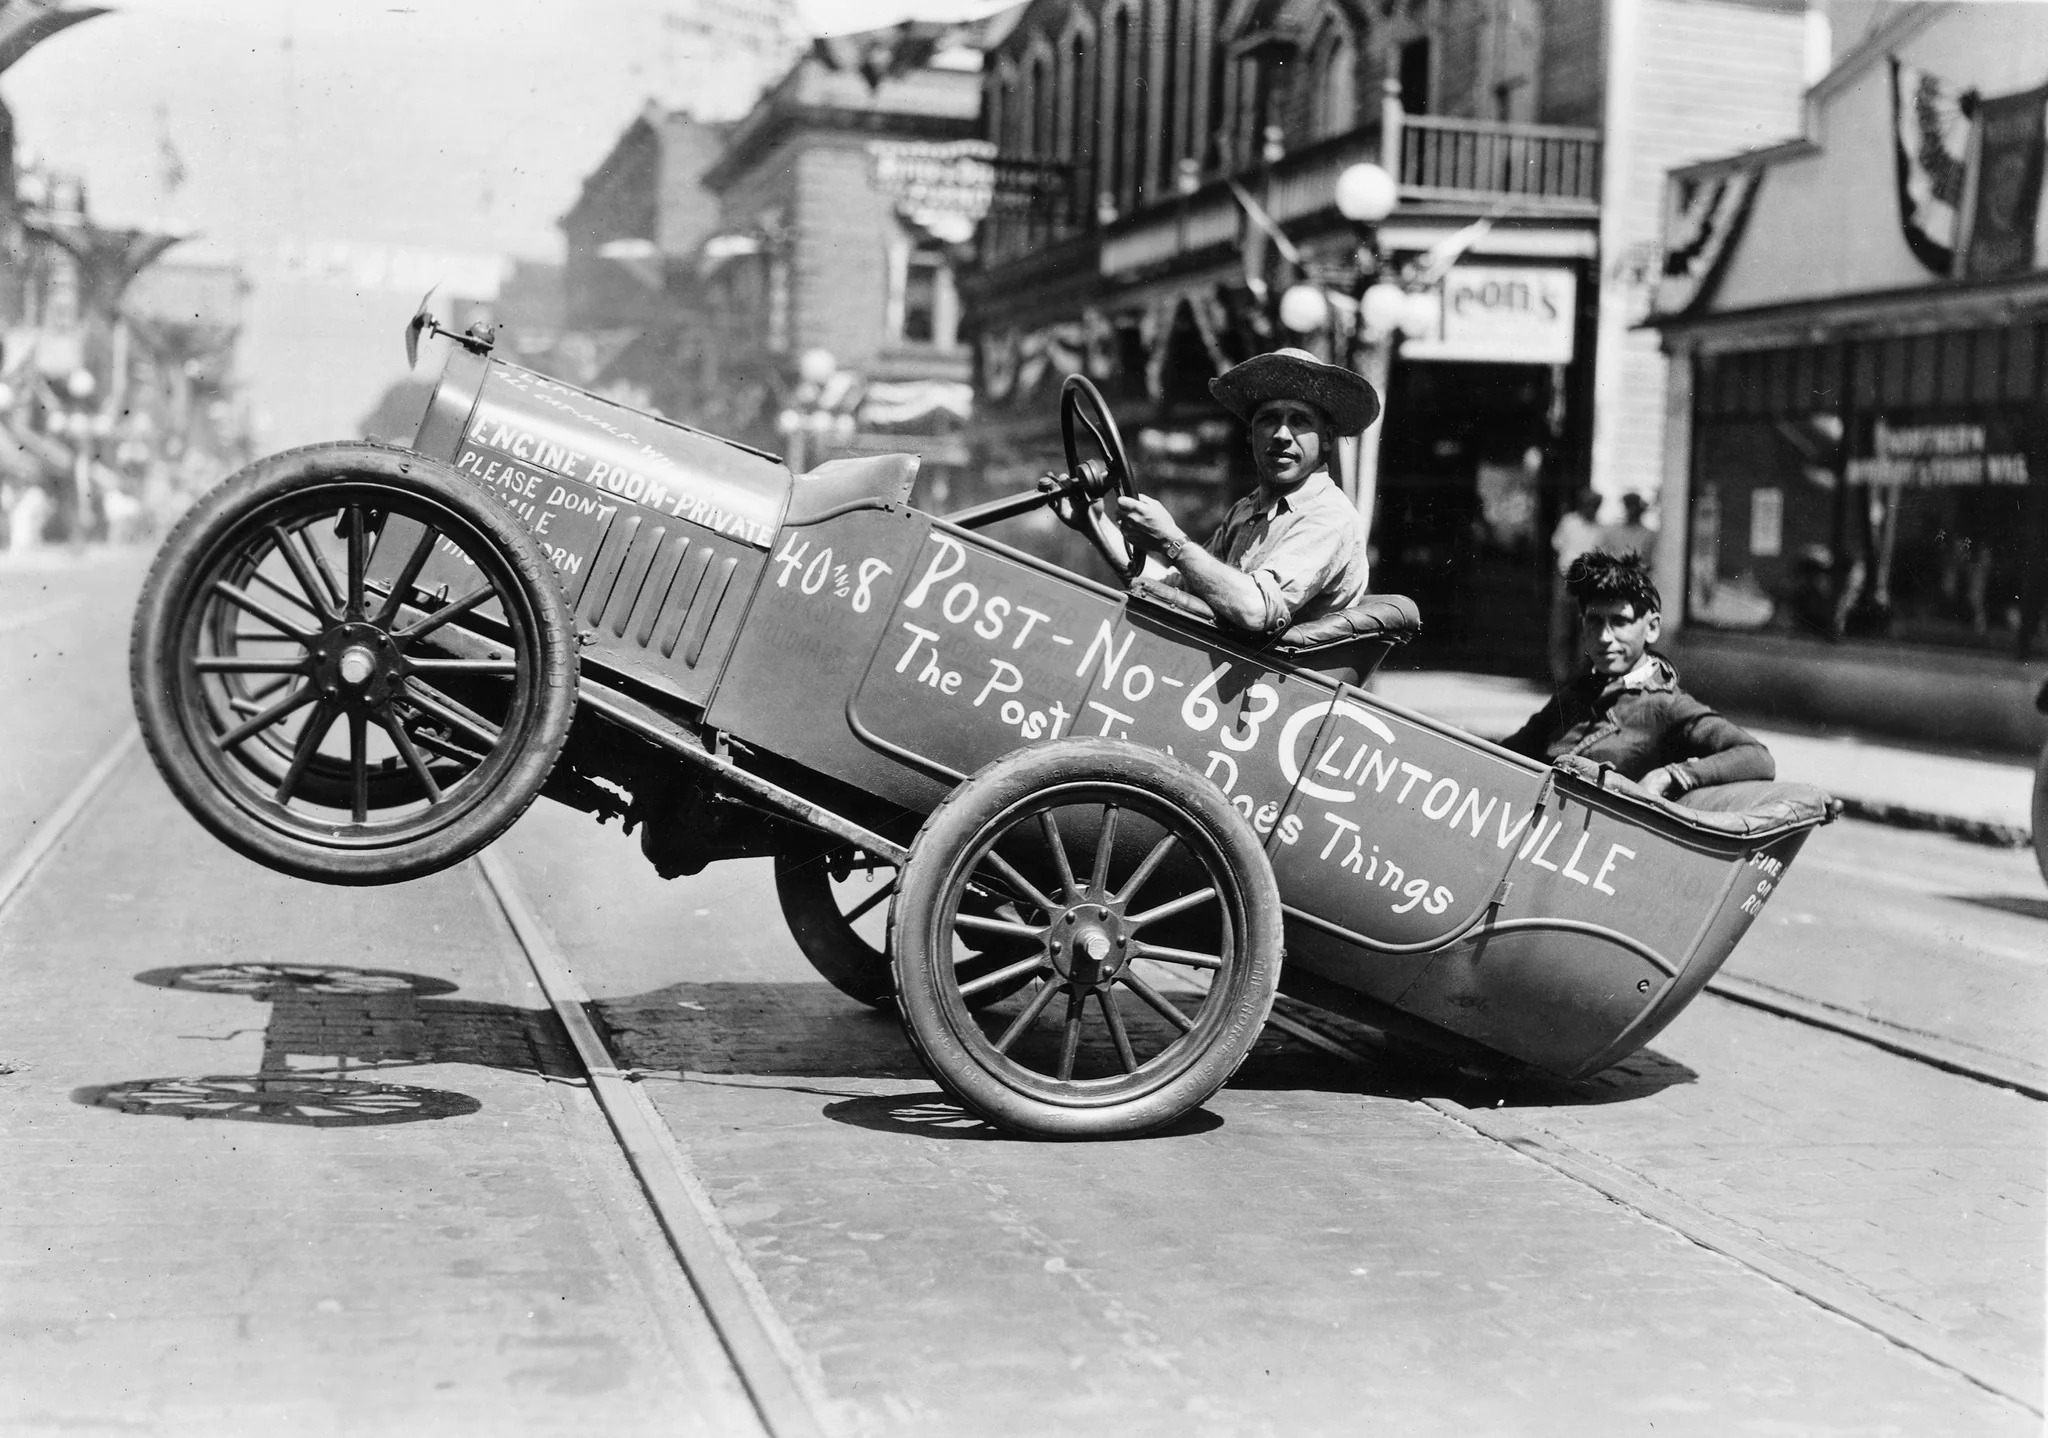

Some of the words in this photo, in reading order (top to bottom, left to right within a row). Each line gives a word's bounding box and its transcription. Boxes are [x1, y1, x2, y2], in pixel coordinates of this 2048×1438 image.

[458, 451, 543, 499] PLEASE
[470, 415, 586, 477] ENGINE
[774, 531, 833, 595] 40
[851, 557, 893, 613] 8
[1181, 661, 1280, 752] 63
[895, 621, 963, 696] The
[973, 658, 1071, 740] Post
[1310, 812, 1455, 916] Things
[1277, 699, 1637, 897] CLINTONVILLE
[1740, 893, 1763, 917] RO
